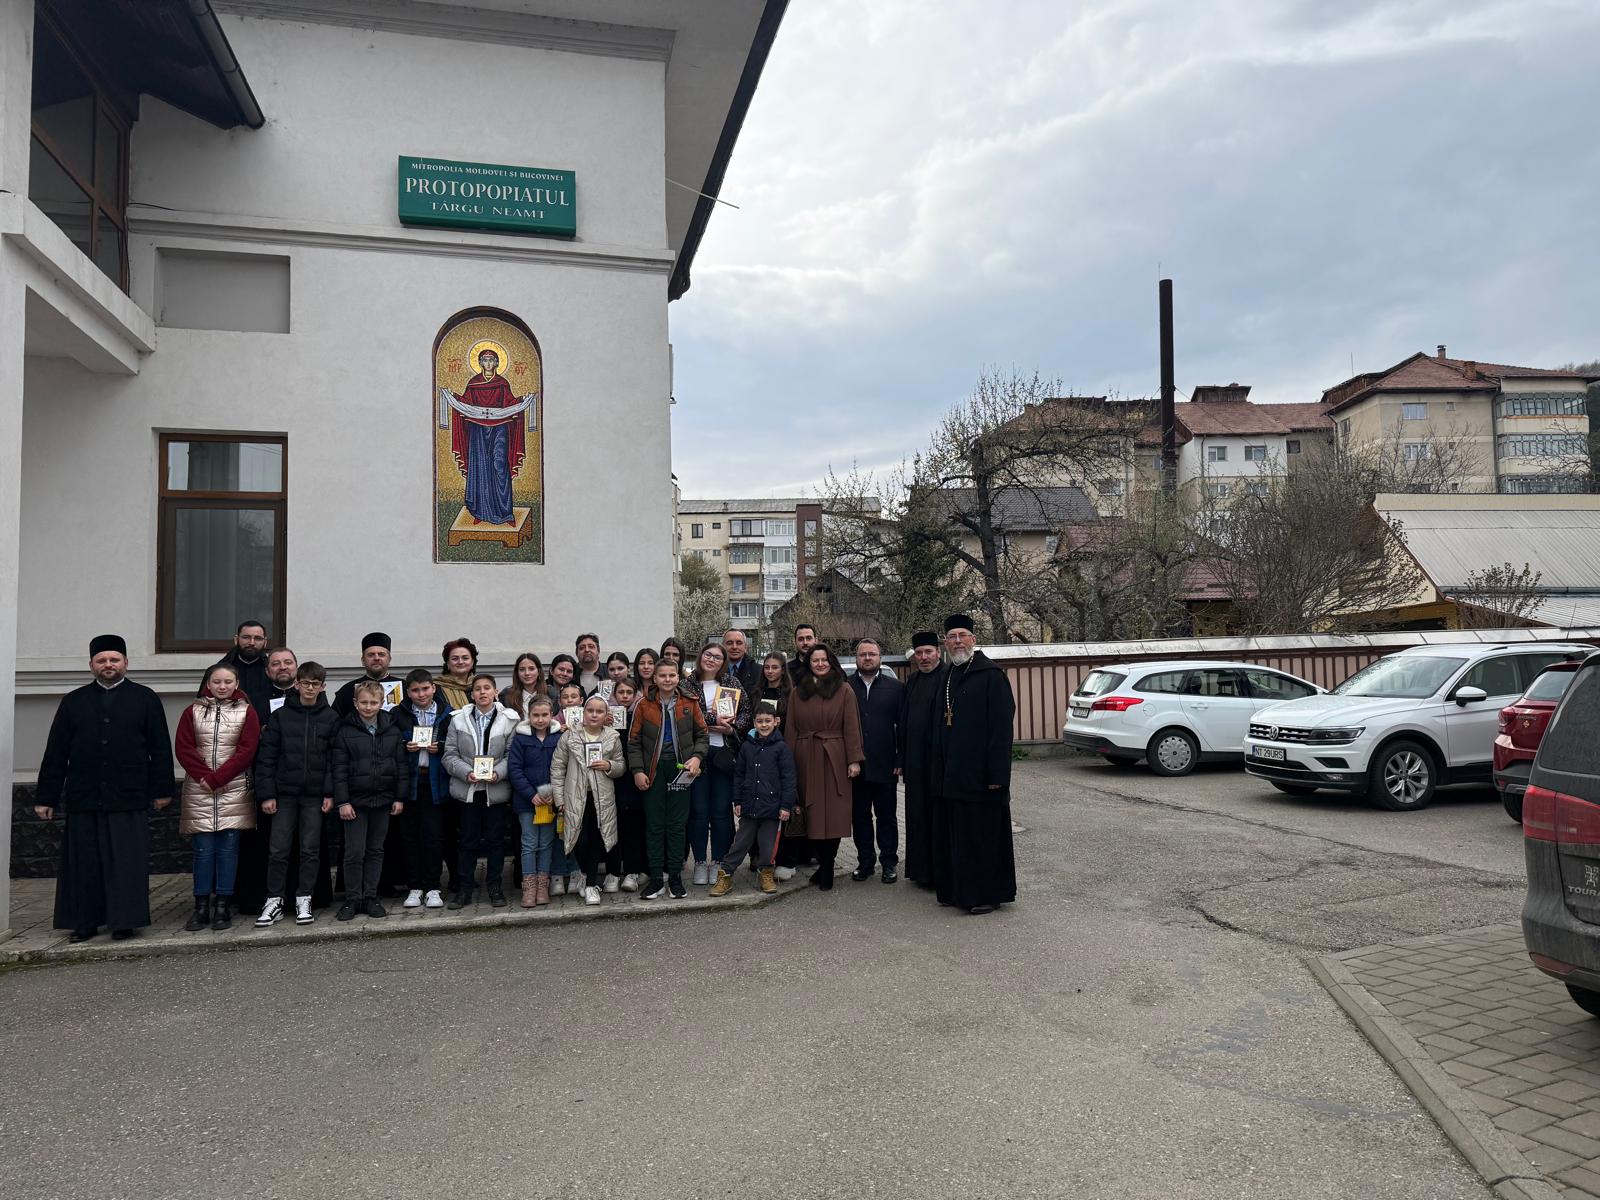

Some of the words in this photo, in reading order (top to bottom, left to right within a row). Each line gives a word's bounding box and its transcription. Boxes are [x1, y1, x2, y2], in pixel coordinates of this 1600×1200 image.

[412, 163, 463, 173] MITROPOLIA
[465, 167, 507, 177] MOLDOVEI
[520, 172, 563, 182] BUCOVINEI
[406, 177, 569, 206] PROTOPOPIATUL
